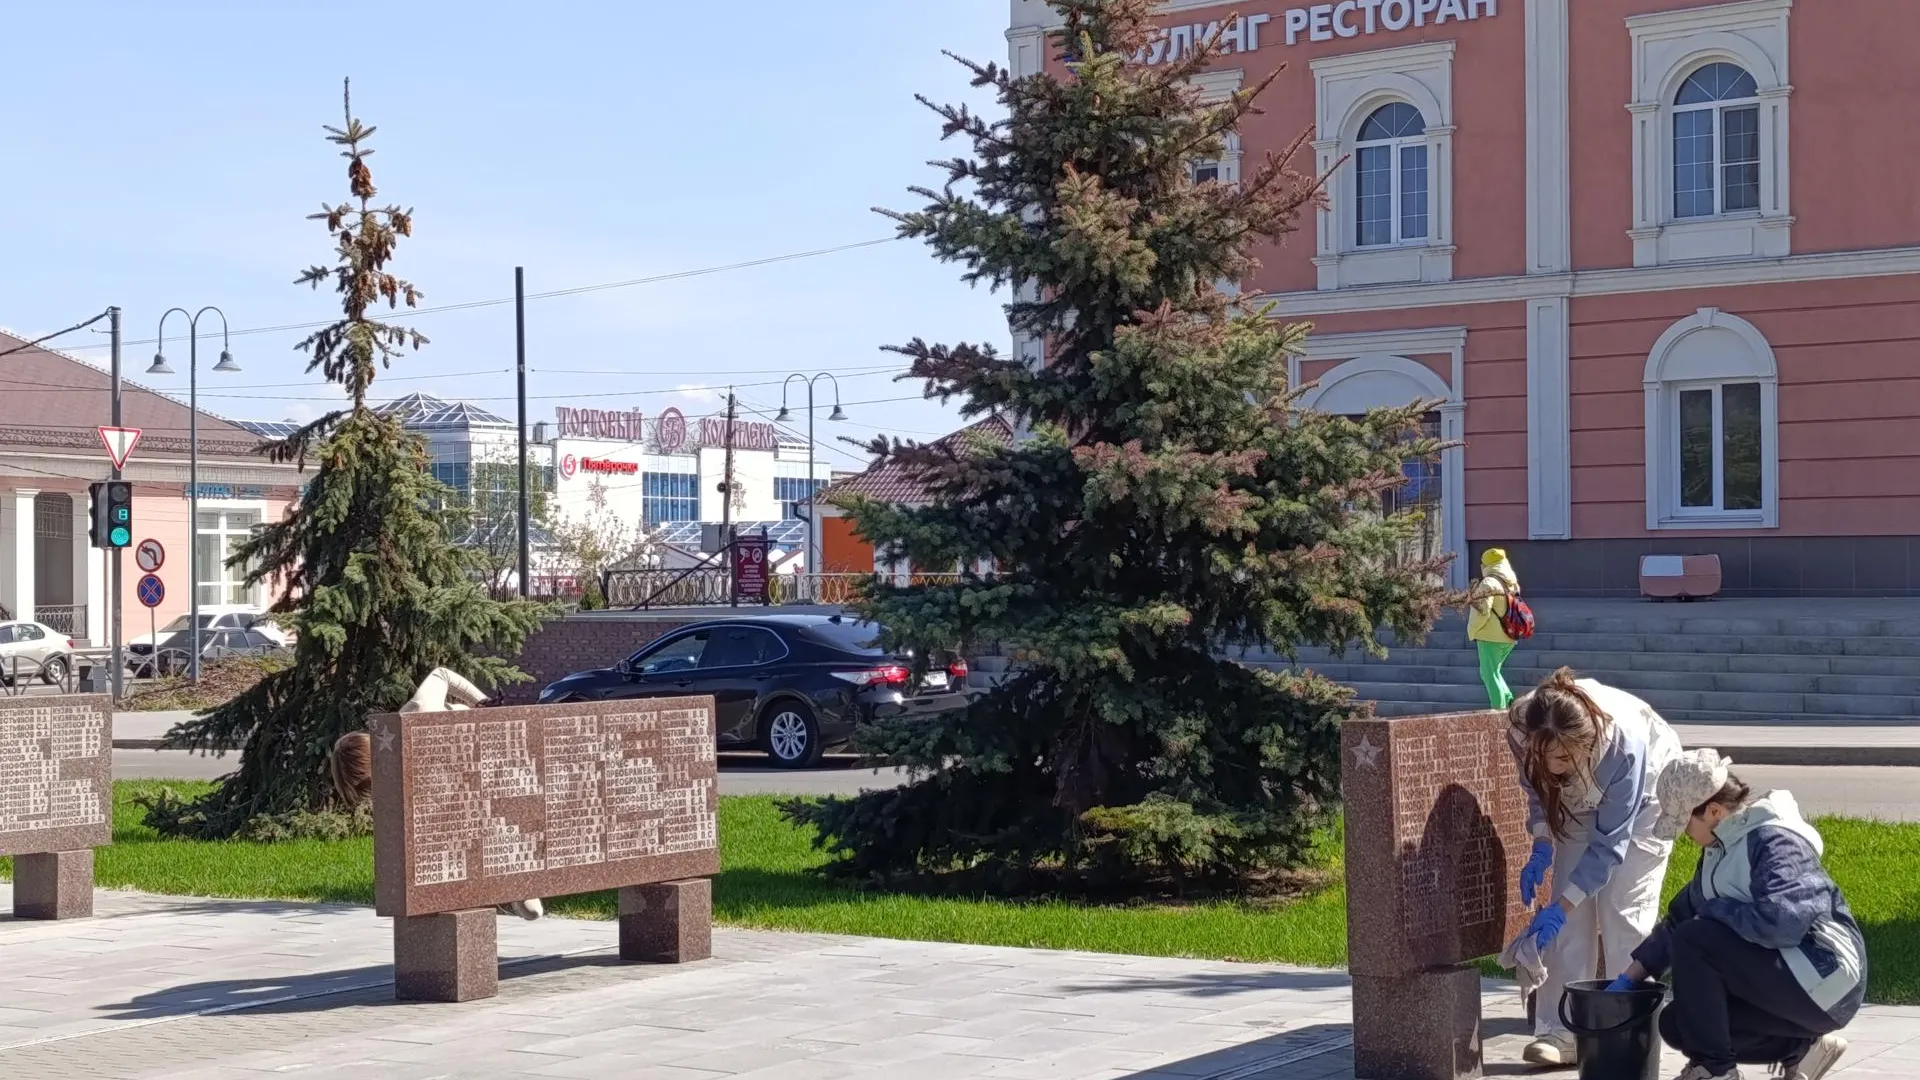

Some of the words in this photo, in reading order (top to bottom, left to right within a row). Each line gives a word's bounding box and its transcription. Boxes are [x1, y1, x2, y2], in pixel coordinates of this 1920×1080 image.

[1128, 13, 1270, 65] УЛИНГ
[1285, 0, 1497, 45] РЕСТОРАН
[556, 406, 642, 441] ТОРГОВЫЙ
[416, 863, 443, 873] ОРЛОВ
[416, 873, 443, 883] ОРЛОВ
